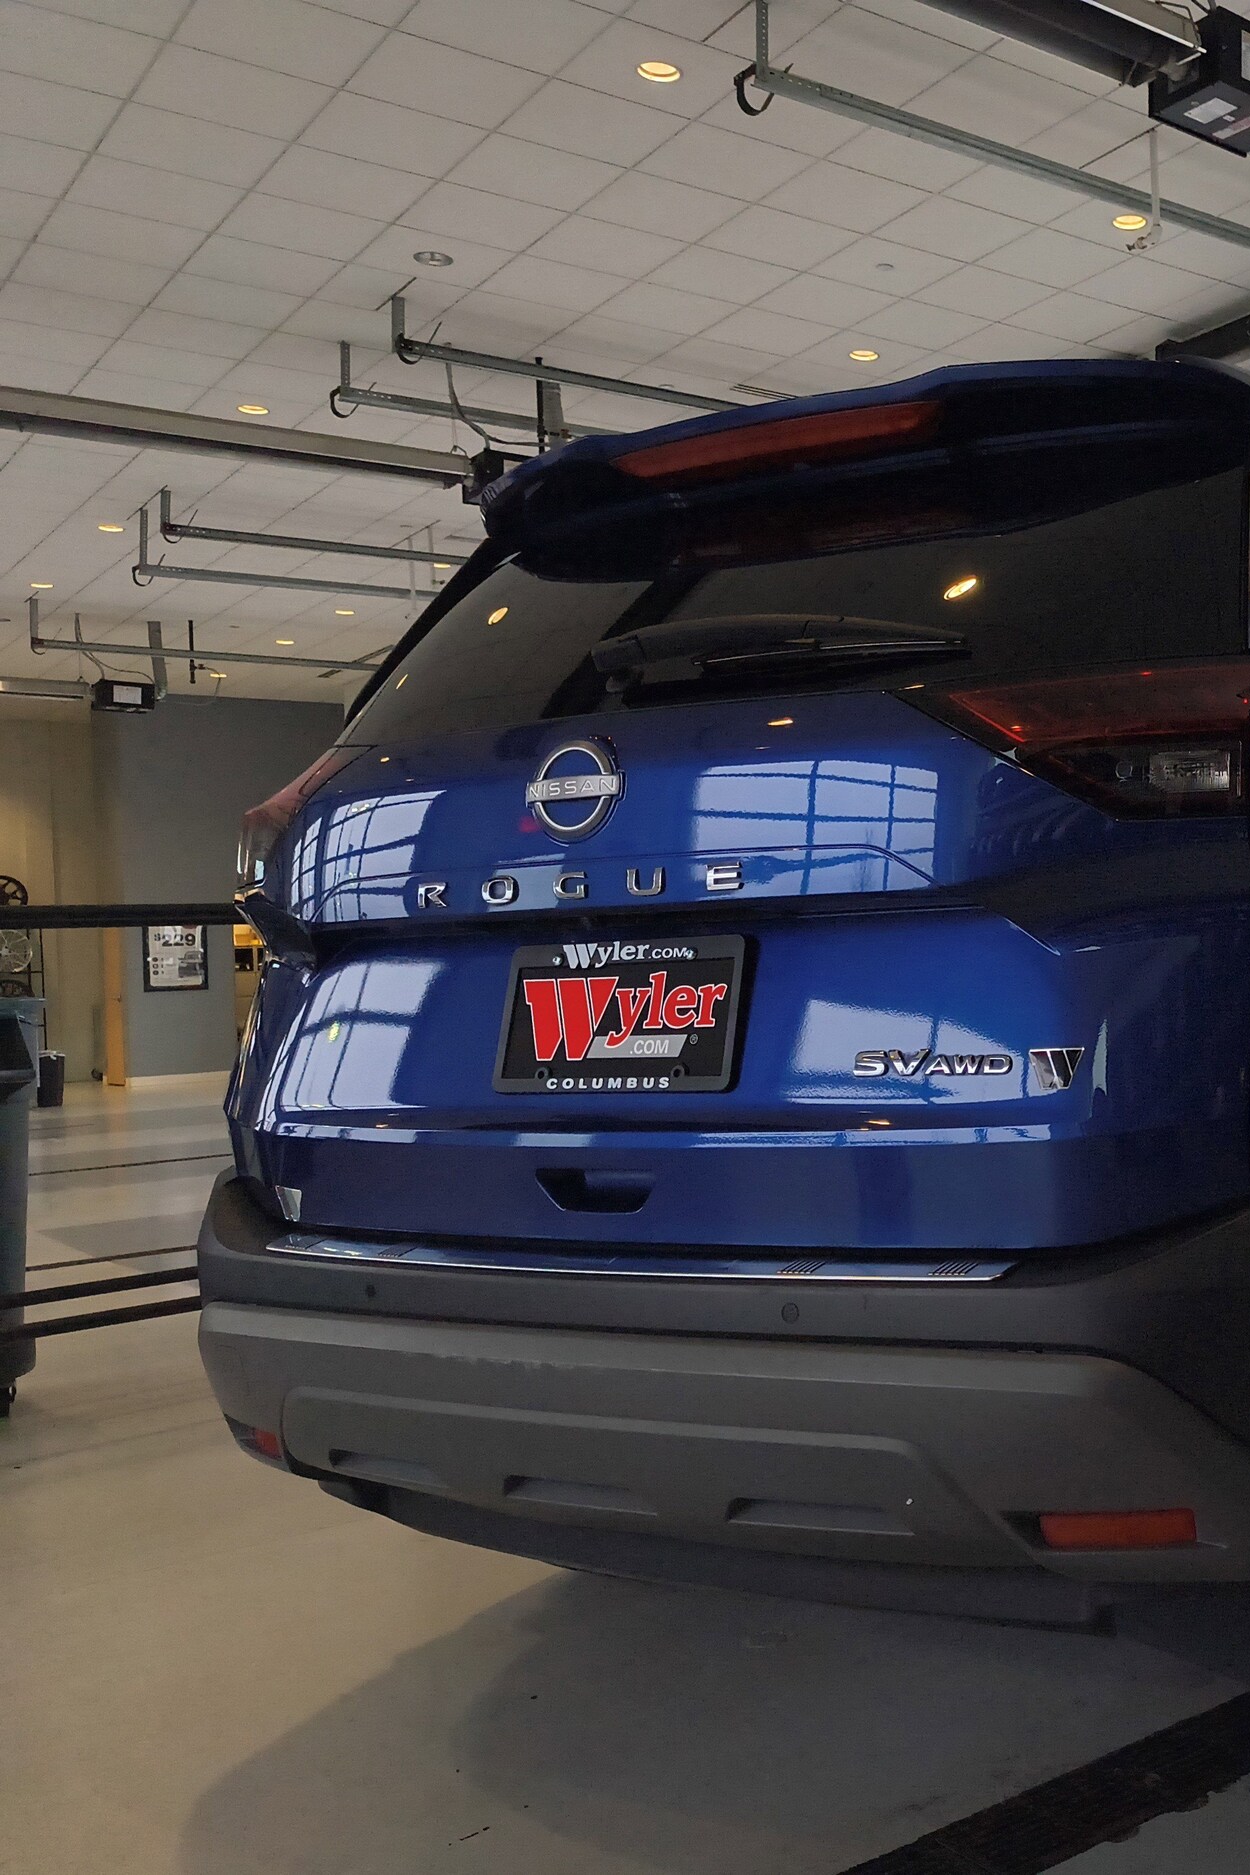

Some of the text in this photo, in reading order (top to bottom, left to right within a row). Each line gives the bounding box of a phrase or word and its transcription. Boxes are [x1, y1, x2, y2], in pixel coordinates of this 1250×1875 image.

[529, 774, 617, 798] NISSAN
[417, 860, 746, 908] ROGUE
[523, 971, 728, 1061] Wyler
[546, 1077, 670, 1089] COLUMBUS
